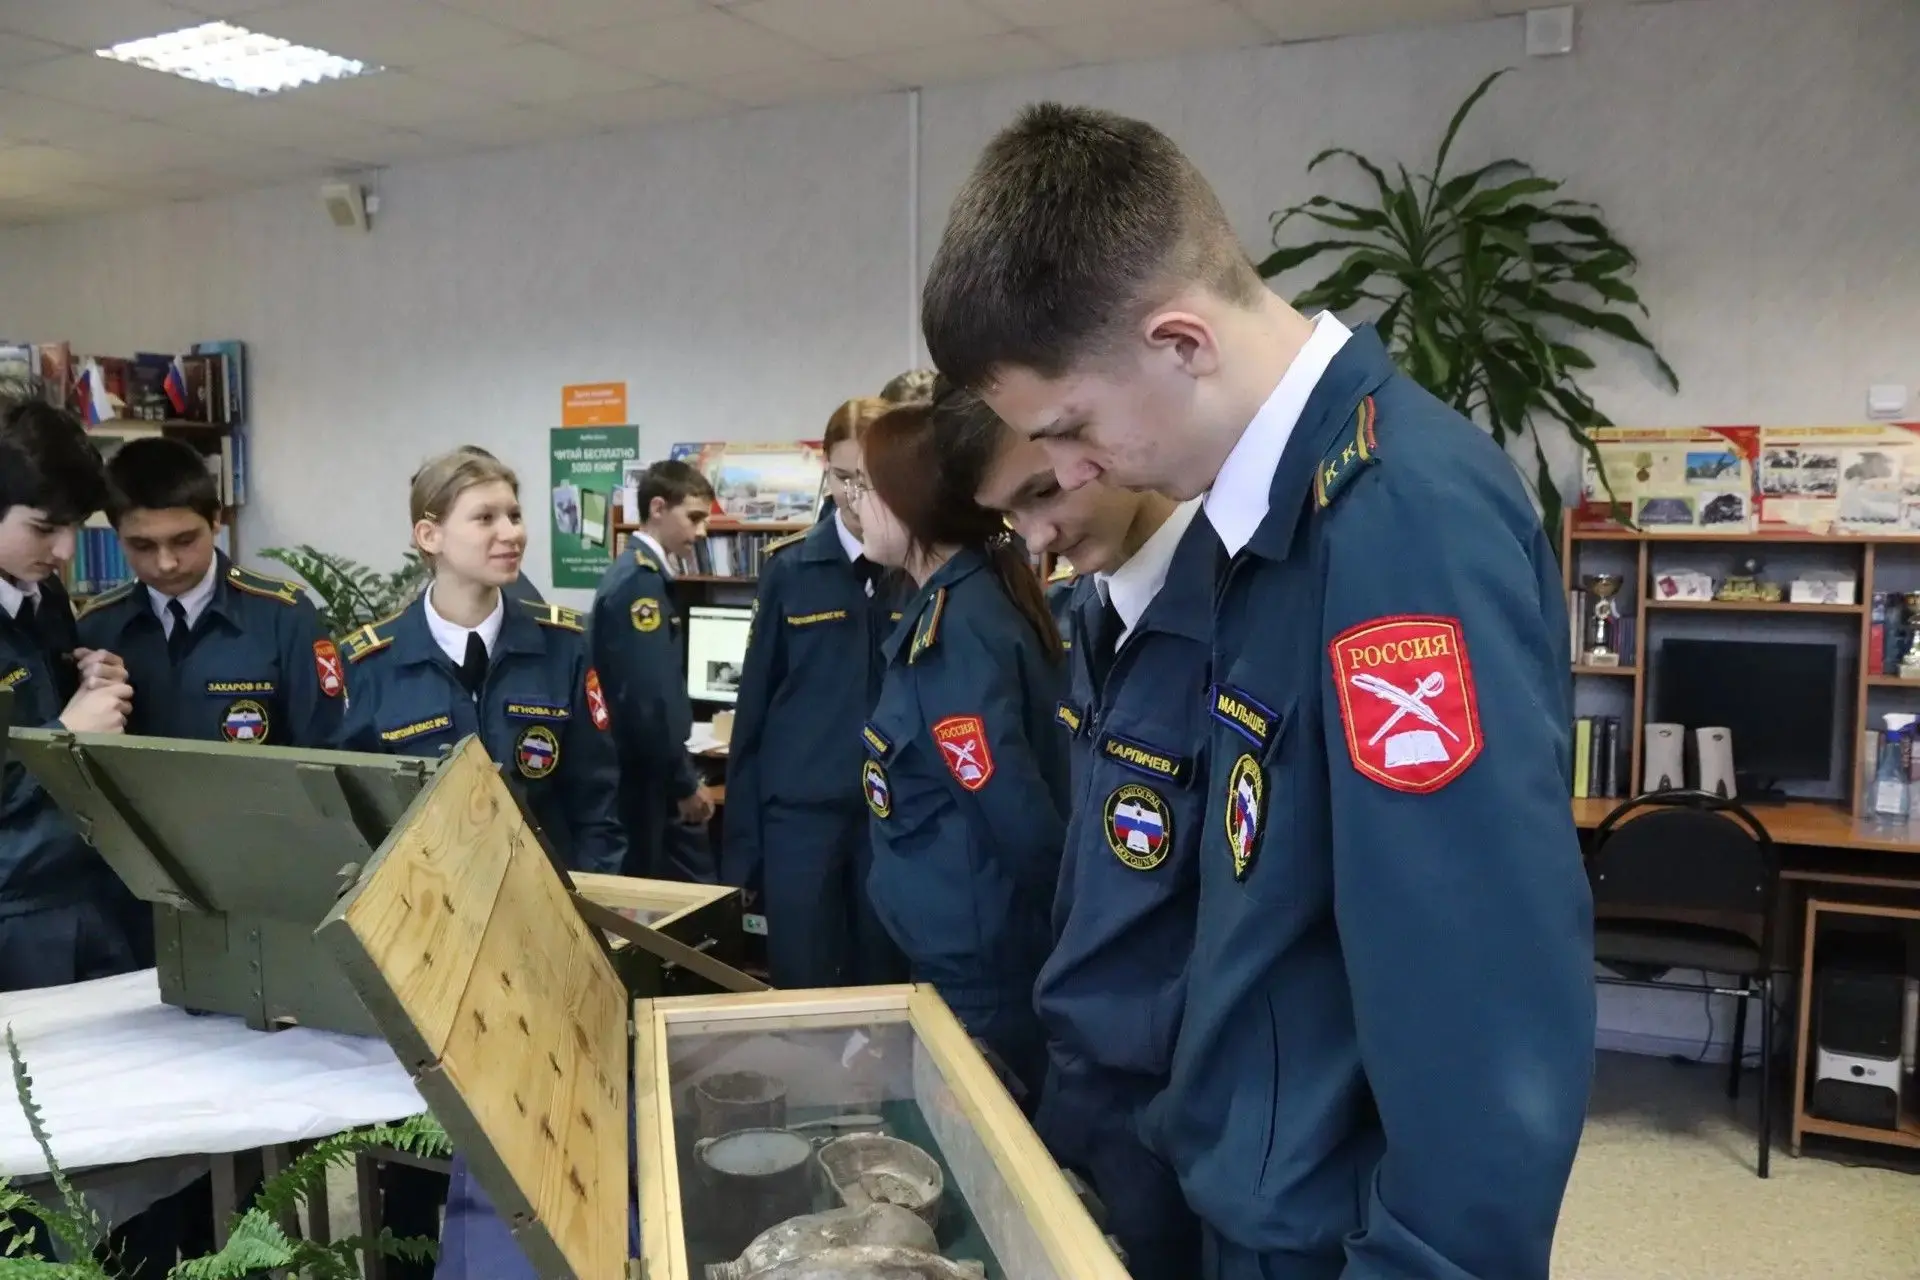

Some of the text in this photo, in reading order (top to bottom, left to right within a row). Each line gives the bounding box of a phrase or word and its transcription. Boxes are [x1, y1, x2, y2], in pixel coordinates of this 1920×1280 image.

[1348, 634, 1450, 669] РОССИЯ
[208, 682, 253, 691] ЗАХАРОВ
[939, 722, 975, 739] РОССИЯ
[1106, 740, 1171, 773] КАРПИЧЕВ
